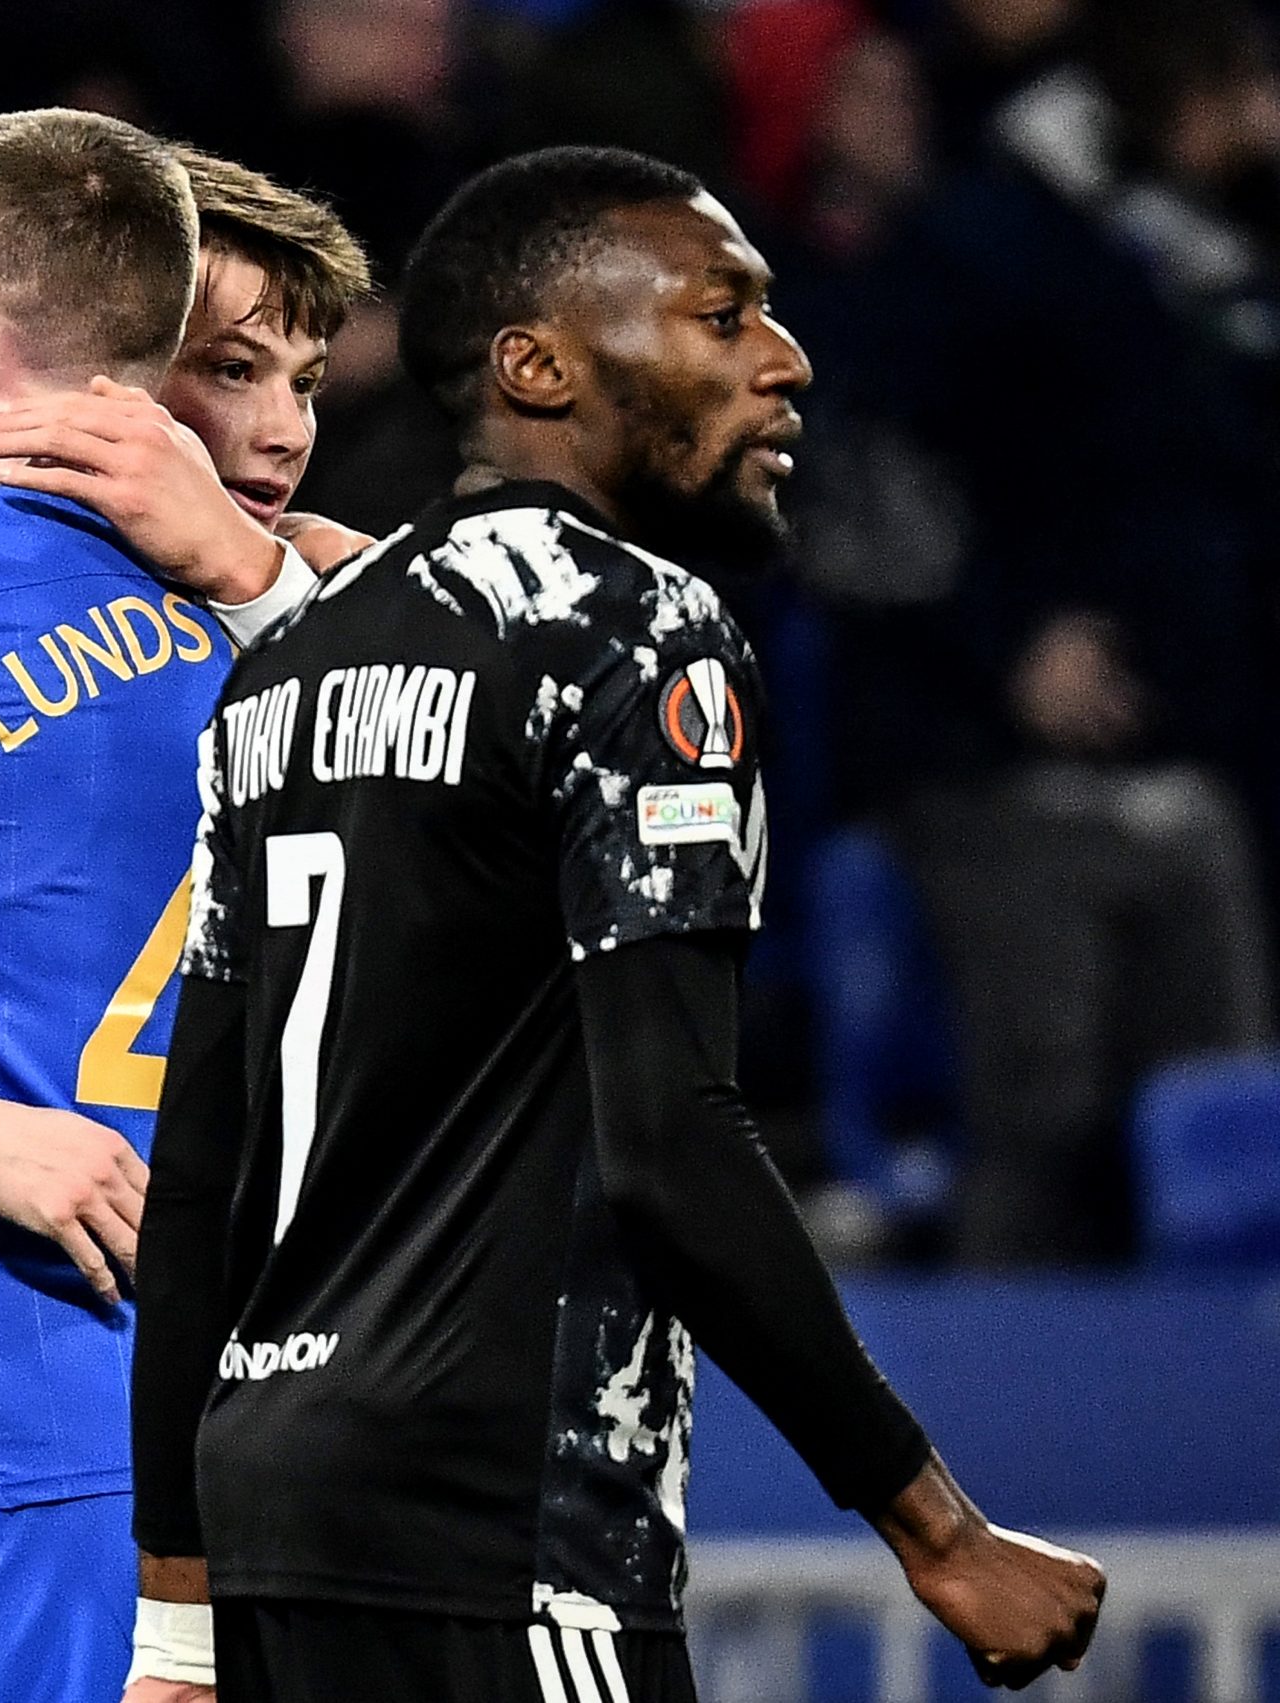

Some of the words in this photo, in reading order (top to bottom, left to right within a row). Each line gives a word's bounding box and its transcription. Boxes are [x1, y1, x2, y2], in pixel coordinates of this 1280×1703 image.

[222, 676, 302, 808] TOKO
[311, 663, 477, 786] EKAMBI
[266, 832, 346, 1246] 7
